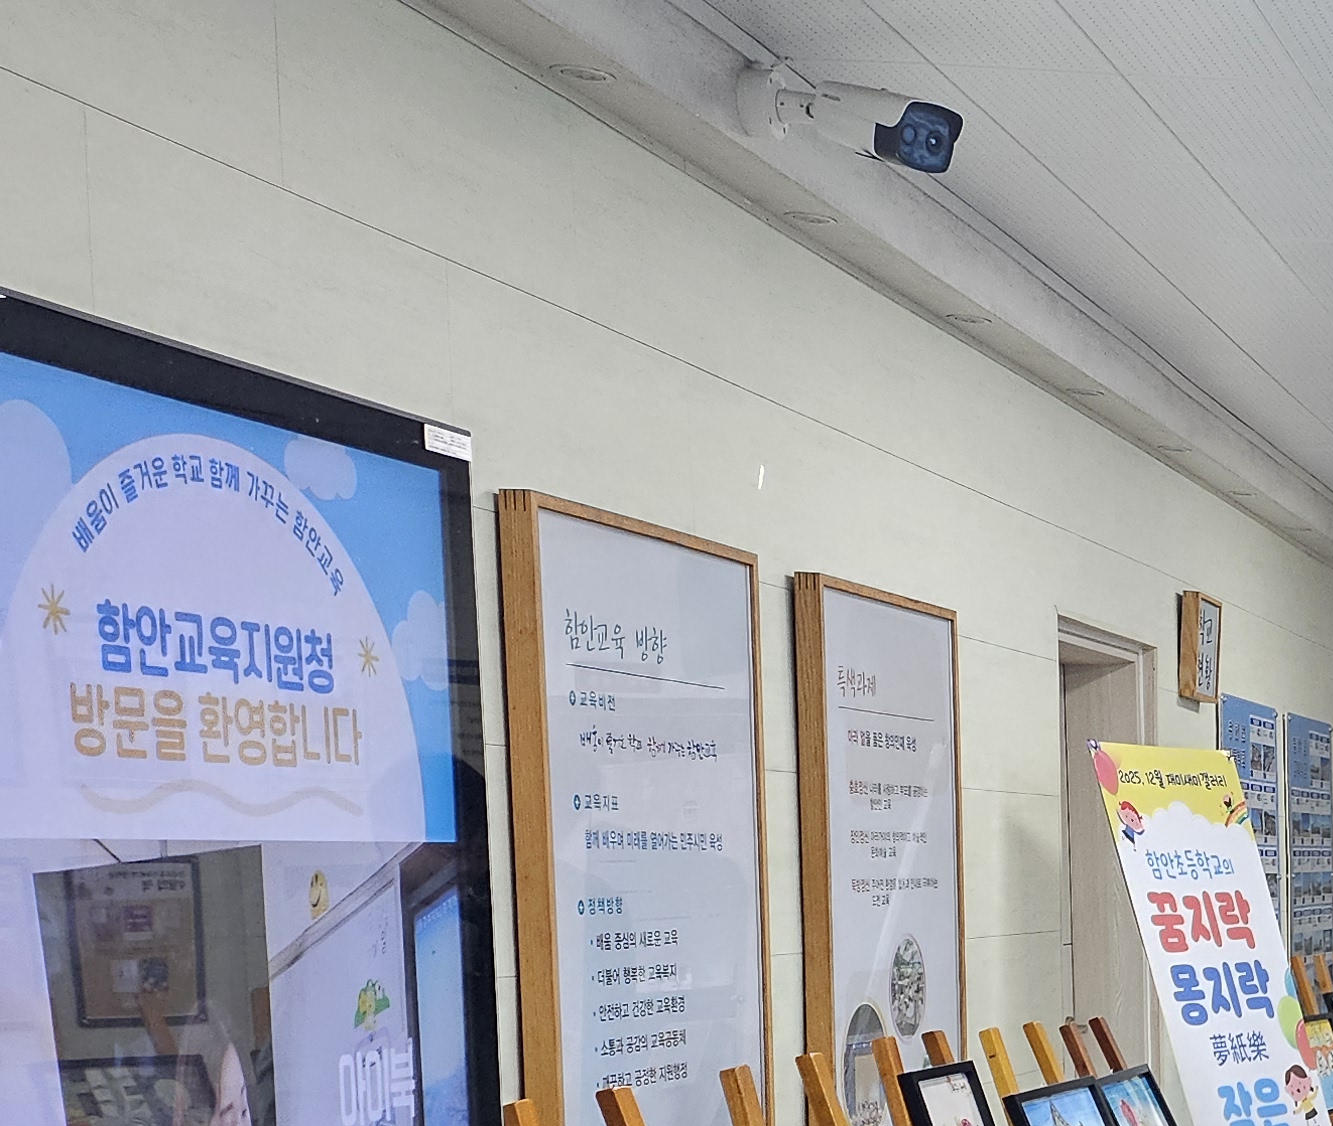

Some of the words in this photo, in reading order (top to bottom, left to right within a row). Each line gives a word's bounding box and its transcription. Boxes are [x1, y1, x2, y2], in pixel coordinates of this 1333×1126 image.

[72, 483, 118, 552] 배움이
[118, 457, 168, 503] 즐거운
[172, 455, 204, 484] 학교
[209, 458, 240, 492] 함께
[247, 471, 289, 525] 가꾸는
[295, 510, 345, 596] 함안교육
[96, 599, 335, 695] 함안교육지원청
[564, 608, 625, 659] 함안교육
[636, 626, 668, 664] 방향
[837, 666, 876, 697] 특색과제
[580, 691, 616, 712] 교육비전
[69, 682, 187, 762] 방문을
[198, 692, 364, 768] 환영합니다
[1145, 770, 1165, 789] 12월
[584, 794, 619, 811] 교육지표
[585, 830, 599, 849] 함께
[602, 830, 624, 850] 배우며
[626, 831, 648, 850] 미래를
[650, 832, 678, 850] 열어가는
[680, 833, 707, 851] 민주시민
[709, 833, 723, 851] 육성
[1145, 849, 1234, 880] 함안초등학교의
[588, 897, 622, 915] 정책방향
[1147, 890, 1256, 952] 꿈지락
[596, 932, 611, 950] 배움
[615, 932, 636, 950] 중심의
[639, 930, 661, 947] 새로운
[664, 930, 678, 946] 교육
[598, 968, 620, 986] 더불어
[623, 966, 645, 984] 행복한
[648, 963, 677, 979] 교육복지
[1170, 960, 1275, 1026] 몽지락
[599, 1002, 629, 1021] 안전하고
[632, 999, 653, 1017] 건강한
[656, 995, 685, 1013] 교육환경
[601, 1038, 624, 1056] 소통과
[626, 1034, 648, 1053] 공감의
[651, 1029, 687, 1049] 교육공동체
[1209, 1030, 1269, 1066] 夢紙樂
[339, 1037, 415, 1126] 아이북
[635, 1068, 656, 1088] 공정한
[659, 1062, 688, 1083] 지원행정
